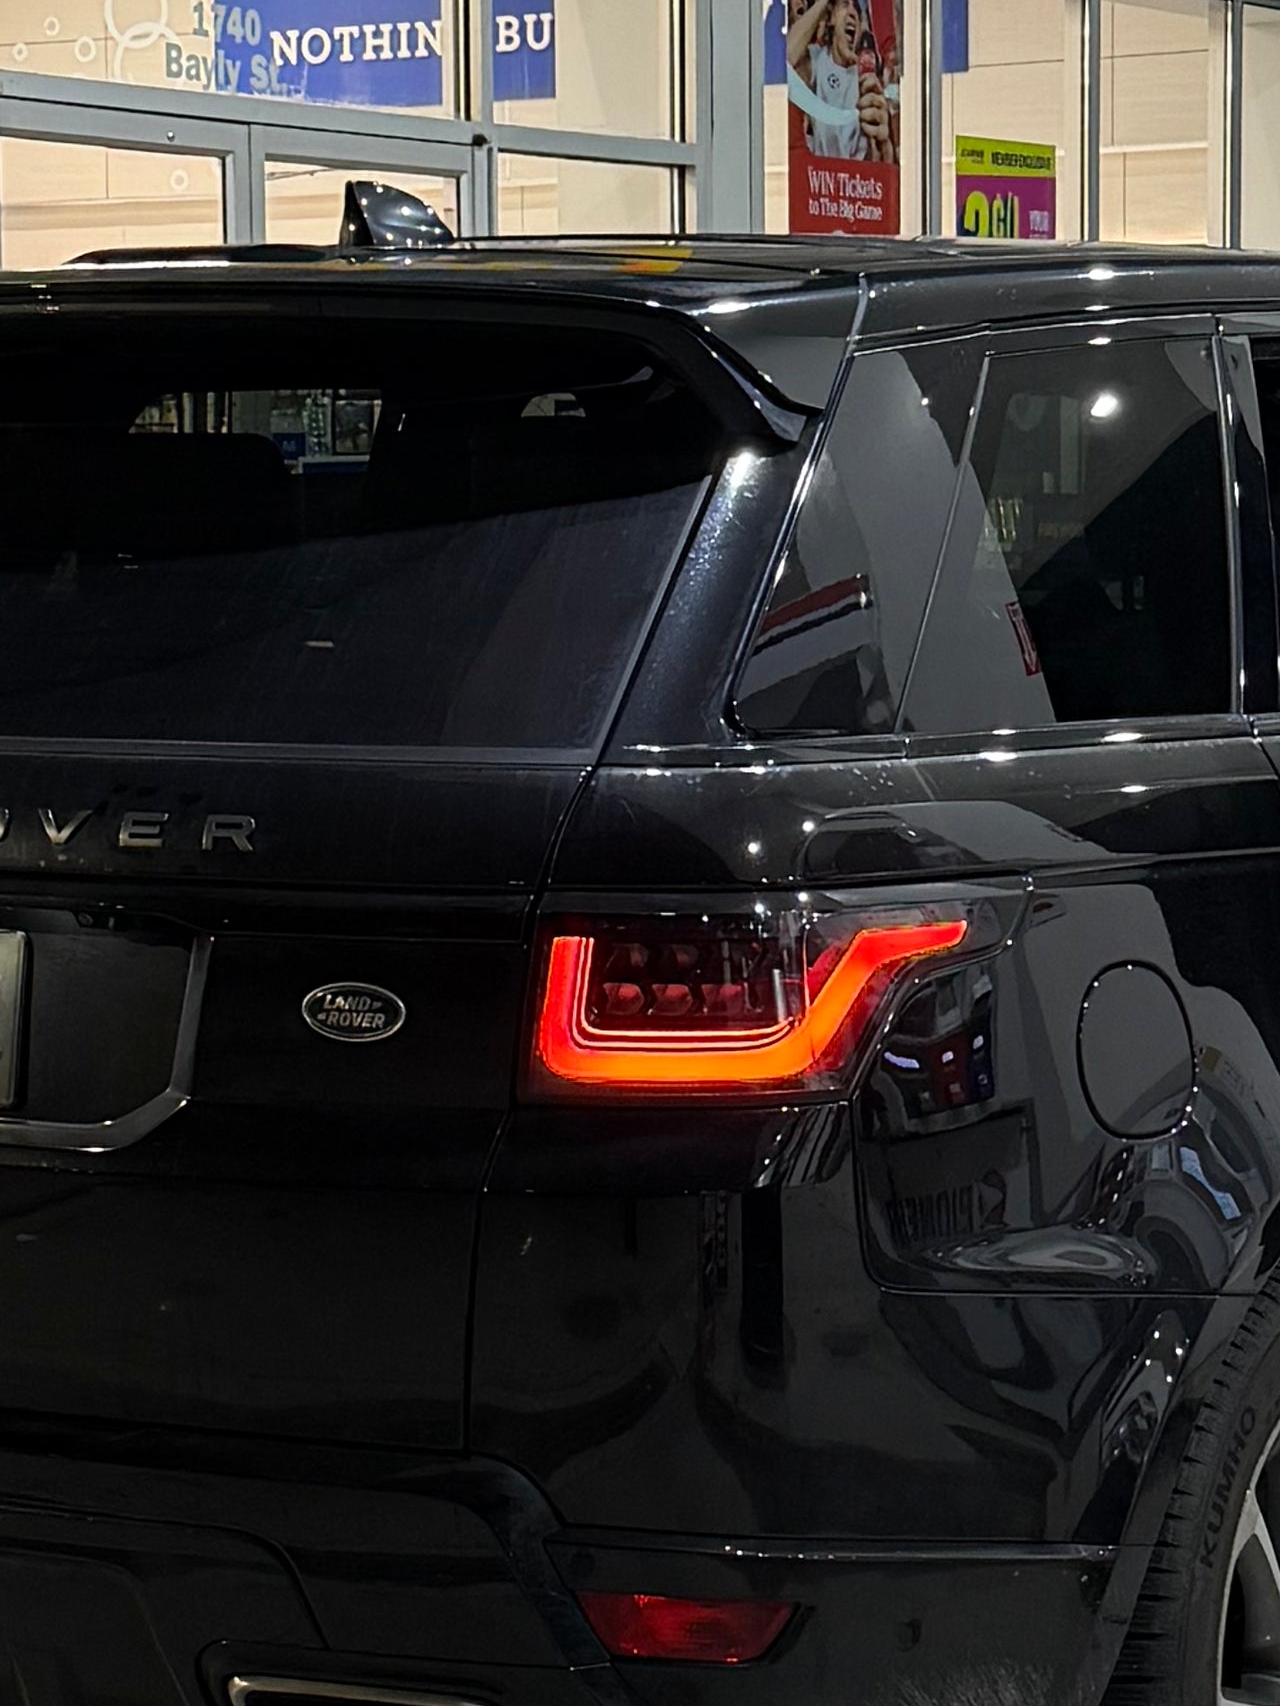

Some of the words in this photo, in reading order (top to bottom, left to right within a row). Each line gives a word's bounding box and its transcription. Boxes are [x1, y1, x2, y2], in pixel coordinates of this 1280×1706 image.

[193, 0, 262, 47] 1740
[270, 20, 442, 66] NOTHIN
[495, 13, 554, 53] BU
[165, 42, 241, 93] Bayly
[808, 166, 835, 196] WIN
[837, 172, 883, 200] Tickets
[809, 198, 819, 215] to
[820, 197, 838, 217] The
[855, 201, 883, 221] Game
[323, 994, 372, 1011] LAND
[326, 1011, 386, 1028] ROVER
[1199, 1405, 1257, 1570] KUMHO
